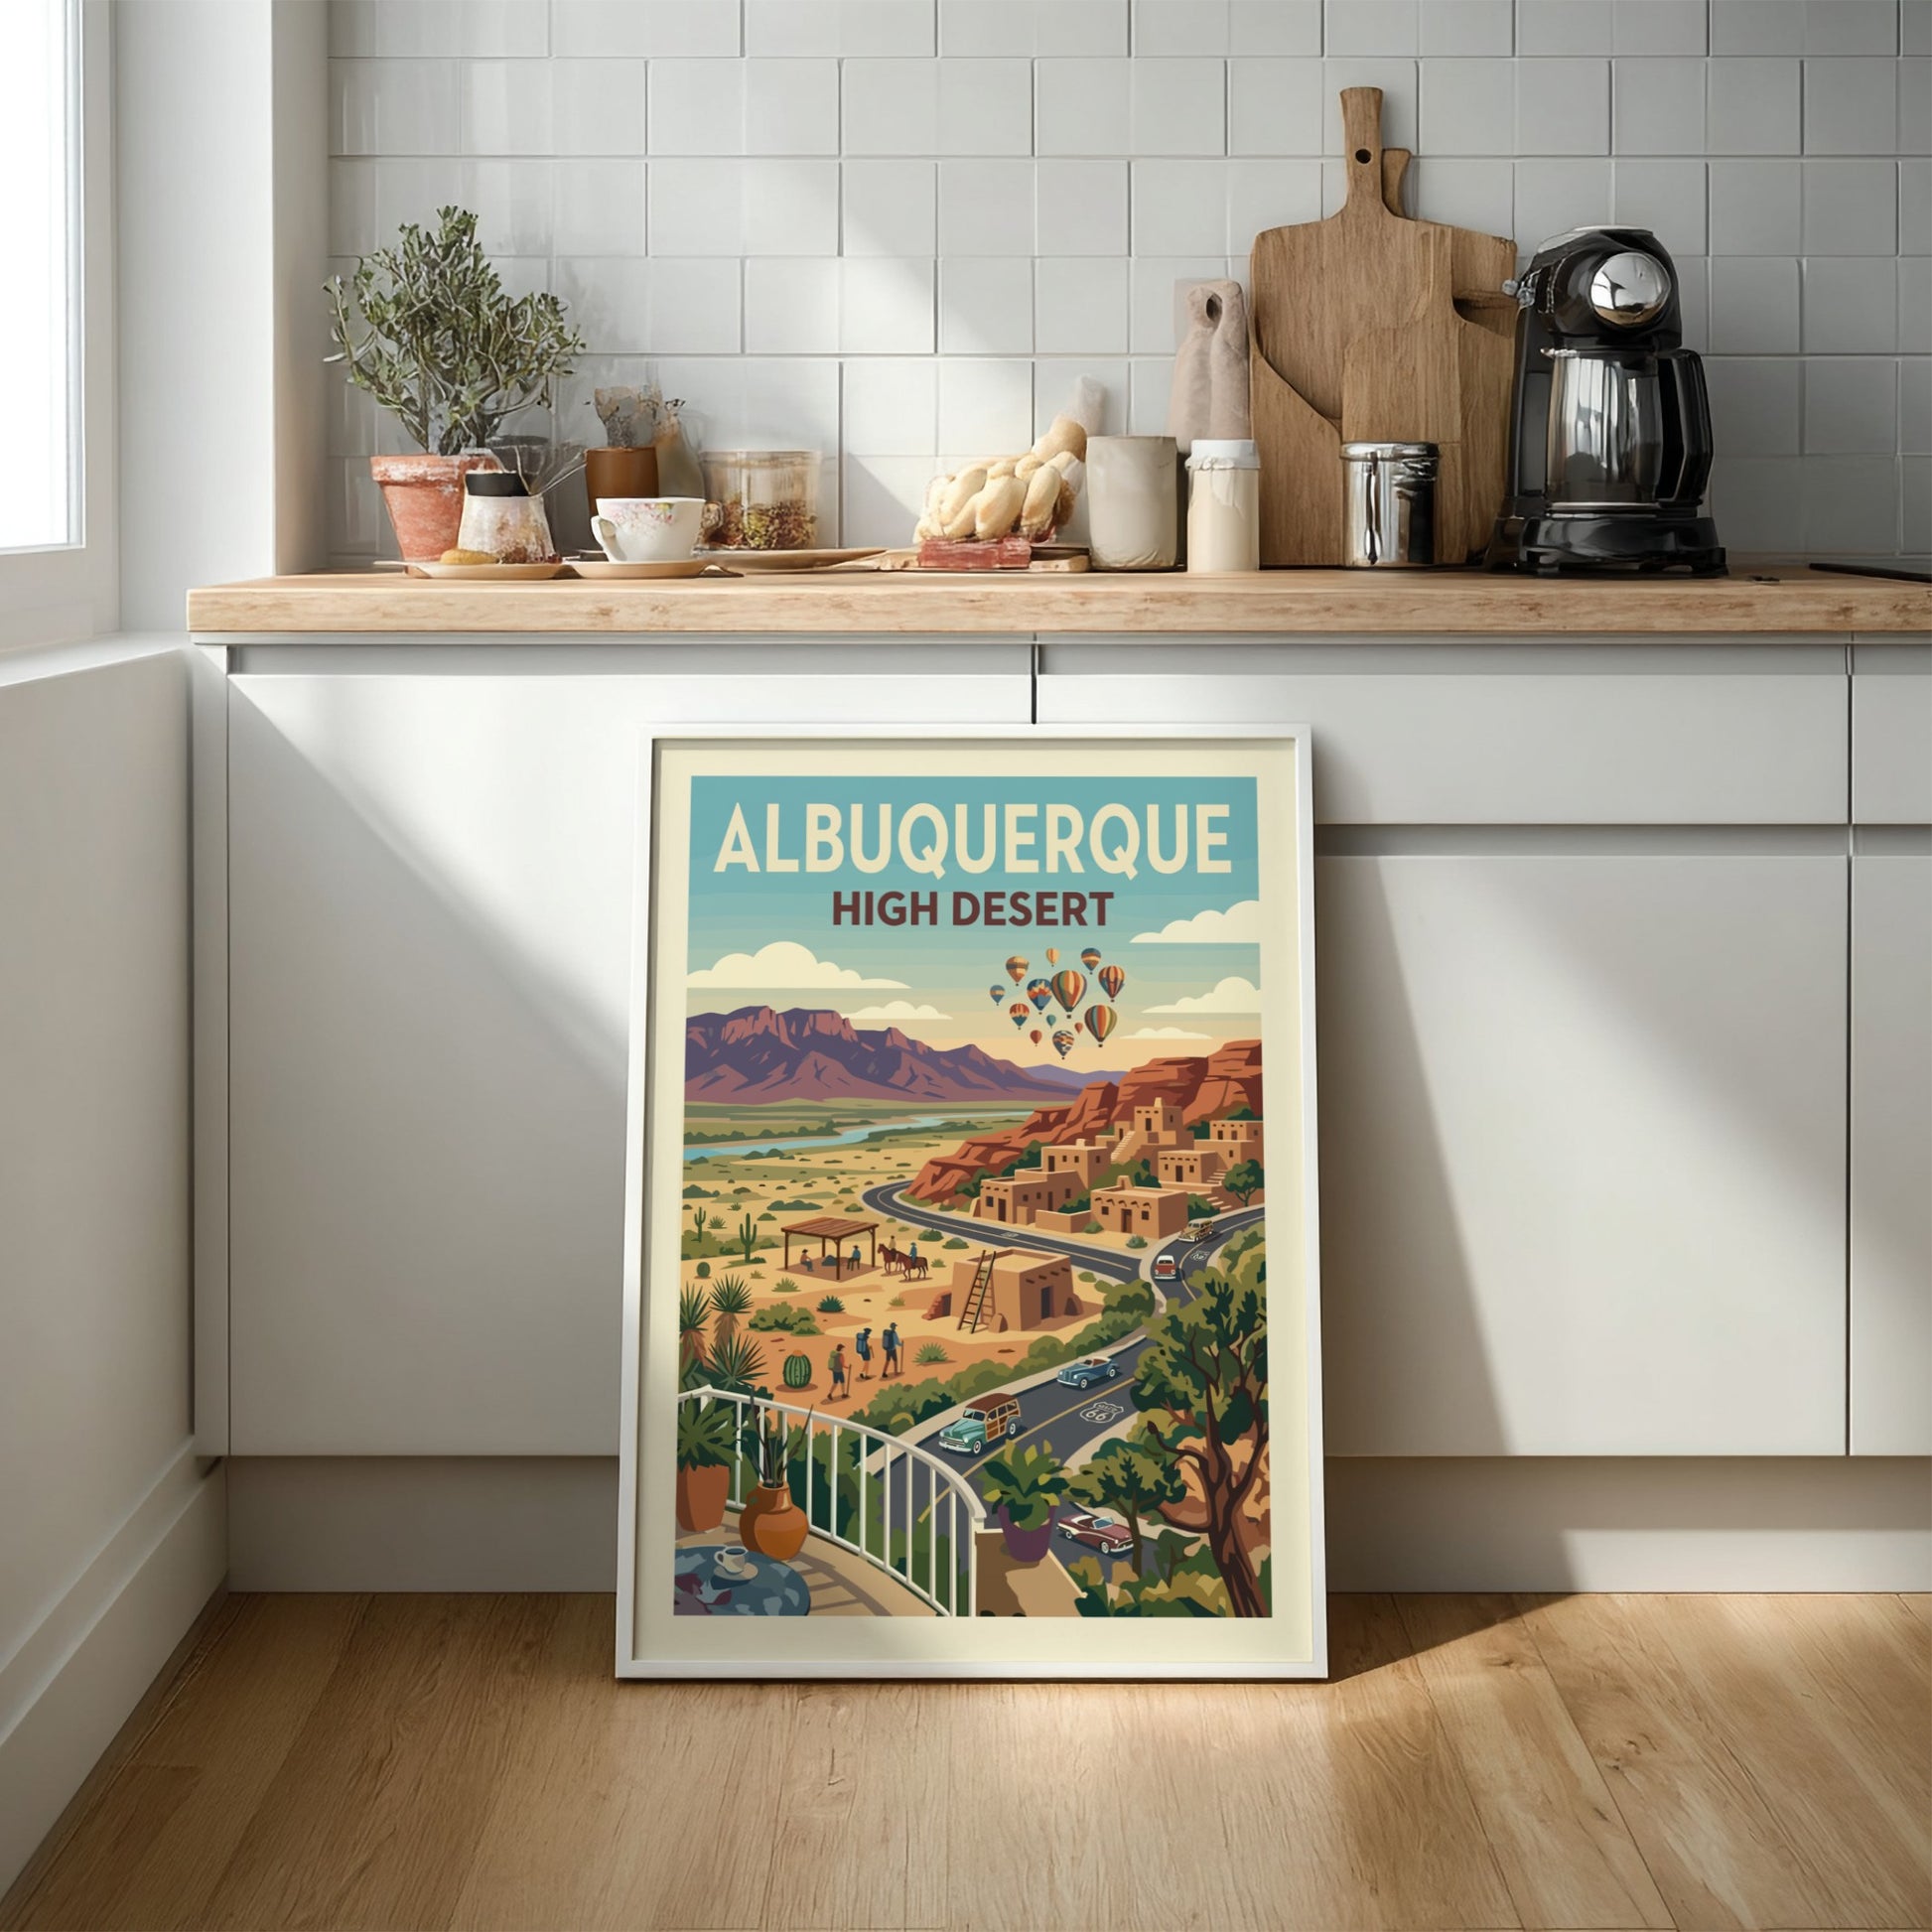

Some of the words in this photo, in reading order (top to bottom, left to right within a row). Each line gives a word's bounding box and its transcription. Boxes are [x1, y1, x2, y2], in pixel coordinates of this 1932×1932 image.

[713, 802, 1232, 881] ALBUQUERQUE
[832, 891, 938, 926] HIGH
[951, 891, 1115, 926] DESERT
